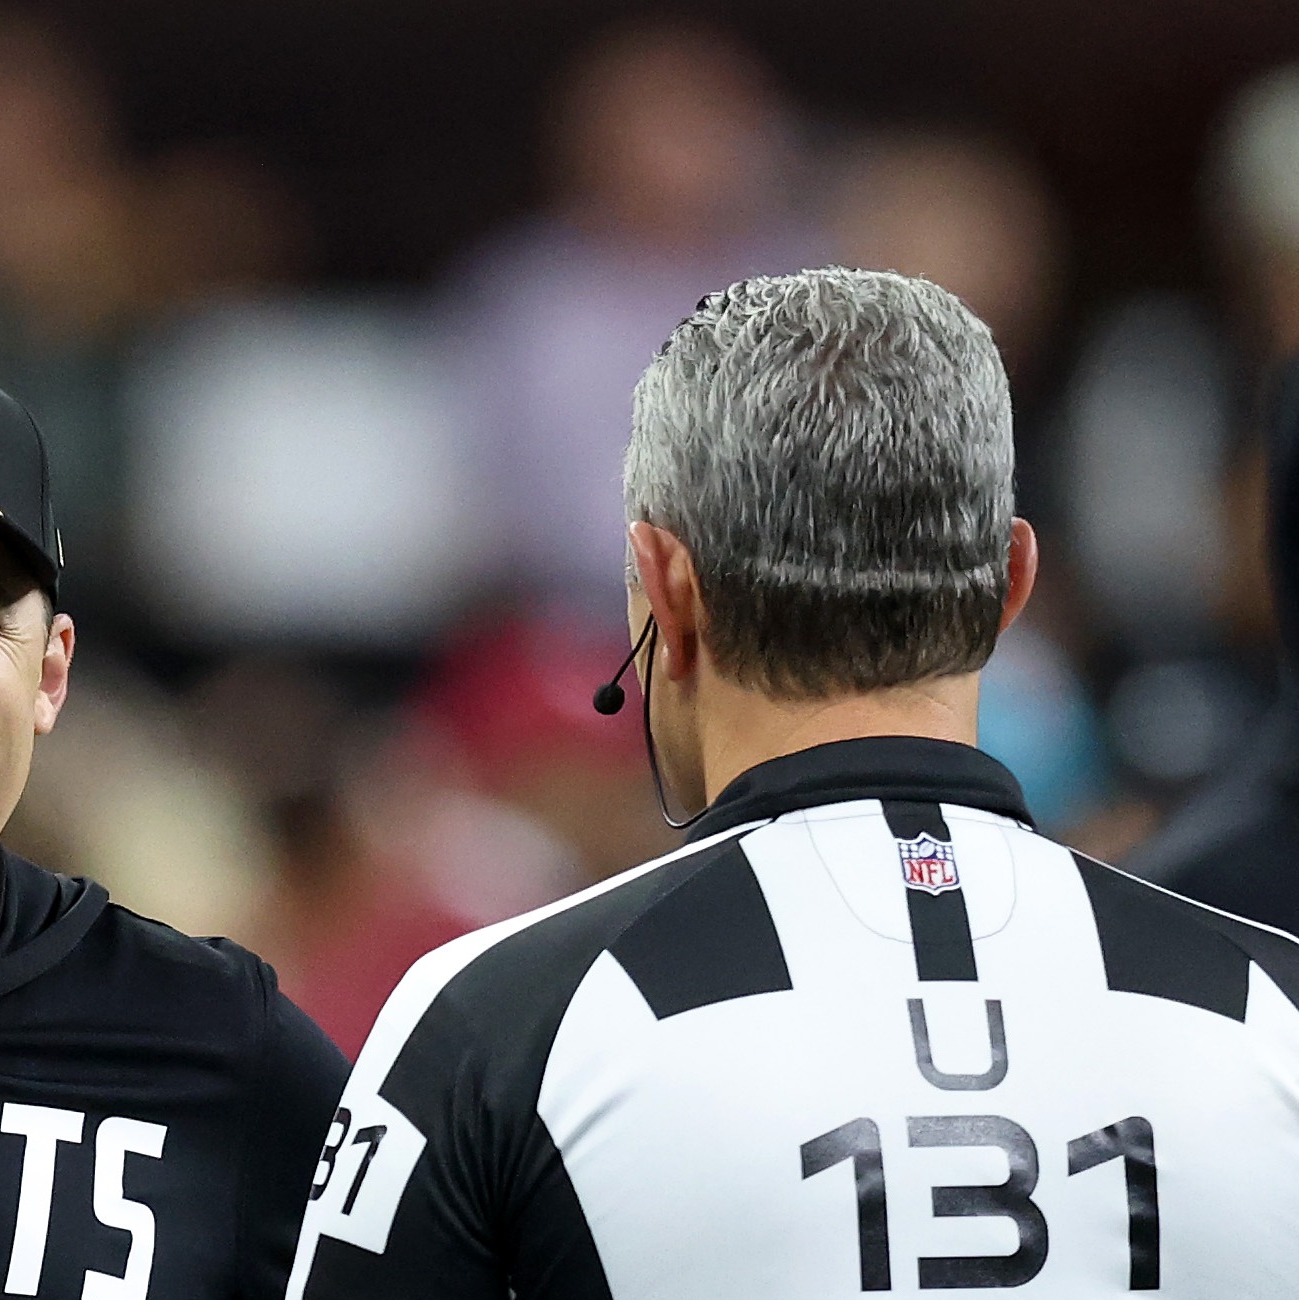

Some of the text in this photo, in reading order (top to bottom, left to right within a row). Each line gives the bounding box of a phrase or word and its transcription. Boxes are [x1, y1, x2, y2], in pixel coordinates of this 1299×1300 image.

[906, 860, 954, 886] NFL
[906, 998, 1010, 1091] U
[799, 1115, 1161, 1292] 131
